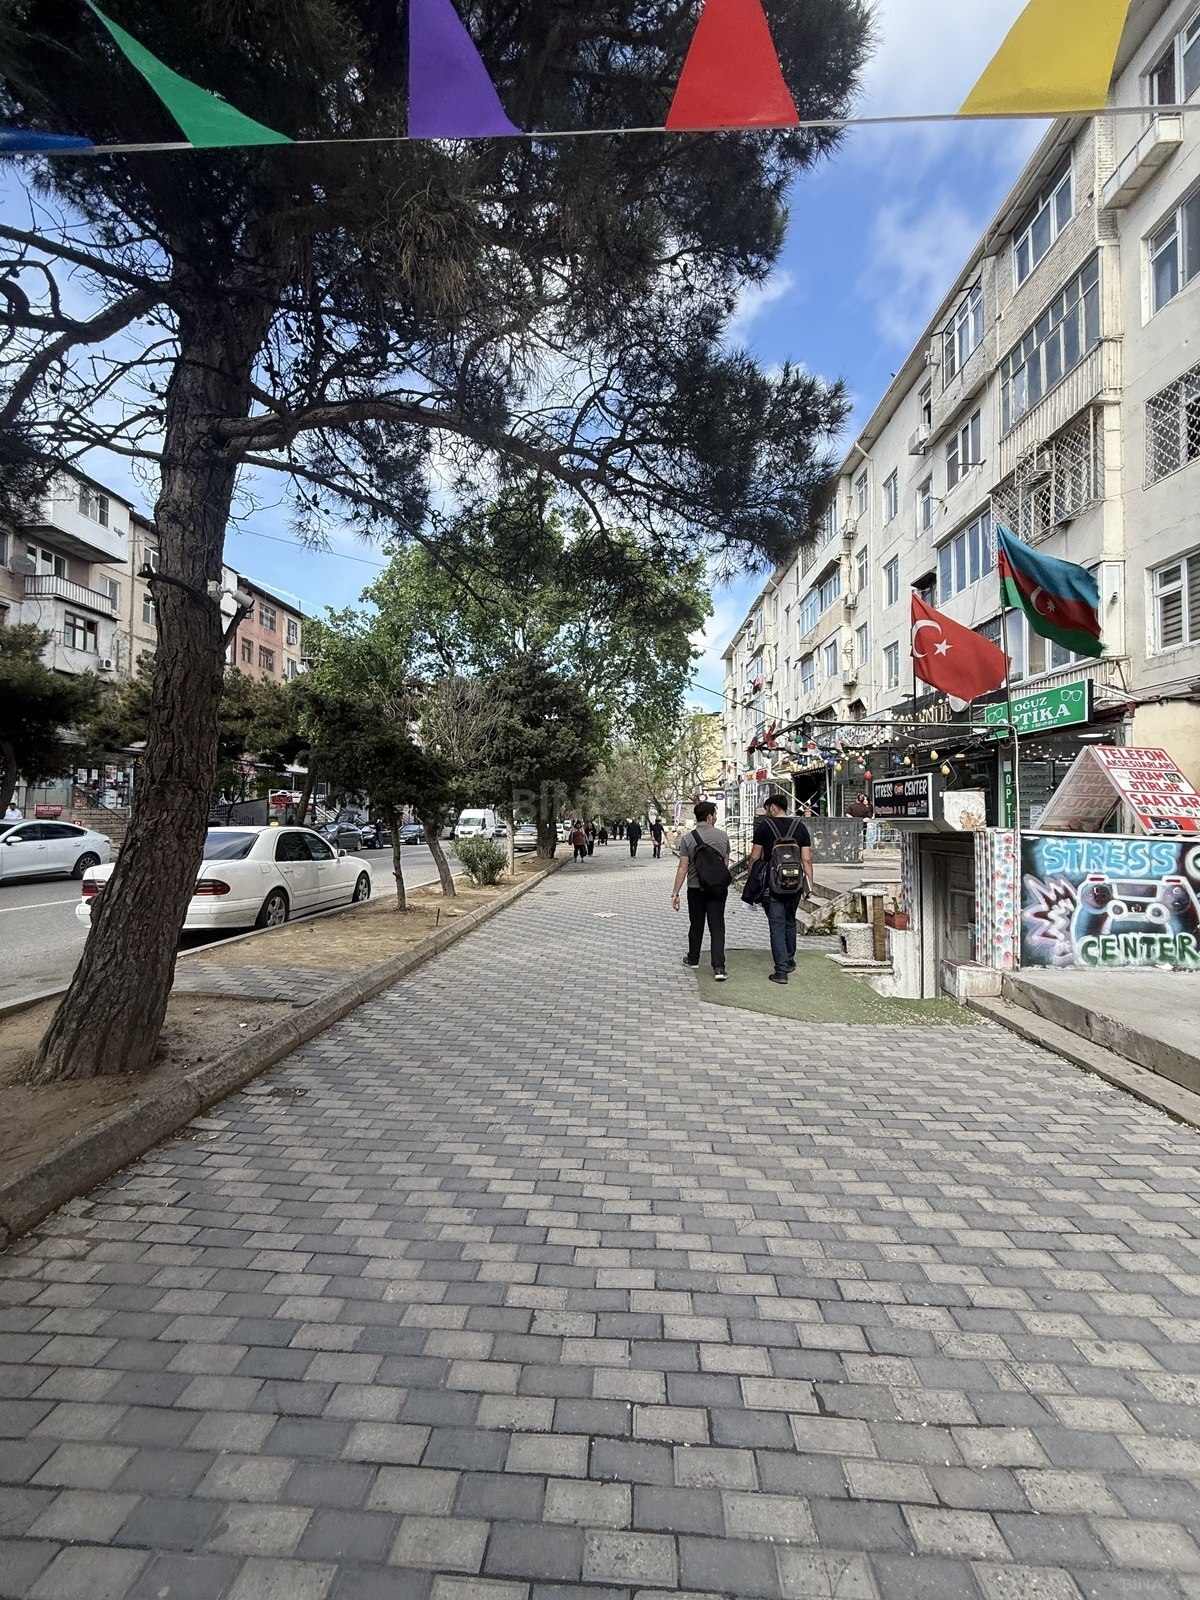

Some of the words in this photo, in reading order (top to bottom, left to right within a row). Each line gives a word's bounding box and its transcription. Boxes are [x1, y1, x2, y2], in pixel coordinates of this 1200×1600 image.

[1014, 696, 1048, 712] OĞUZ
[1097, 748, 1168, 762] TELEFON
[1106, 760, 1175, 770] AKSESUARLARI
[1128, 770, 1167, 781] QRAM
[875, 783, 893, 799] STRESS
[904, 779, 928, 796] CENTER
[1129, 780, 1184, 793] ƏTİRLƏR
[1130, 794, 1200, 809] SAATLAR
[1043, 841, 1177, 874] STRESS
[1081, 933, 1199, 965] CENTER
